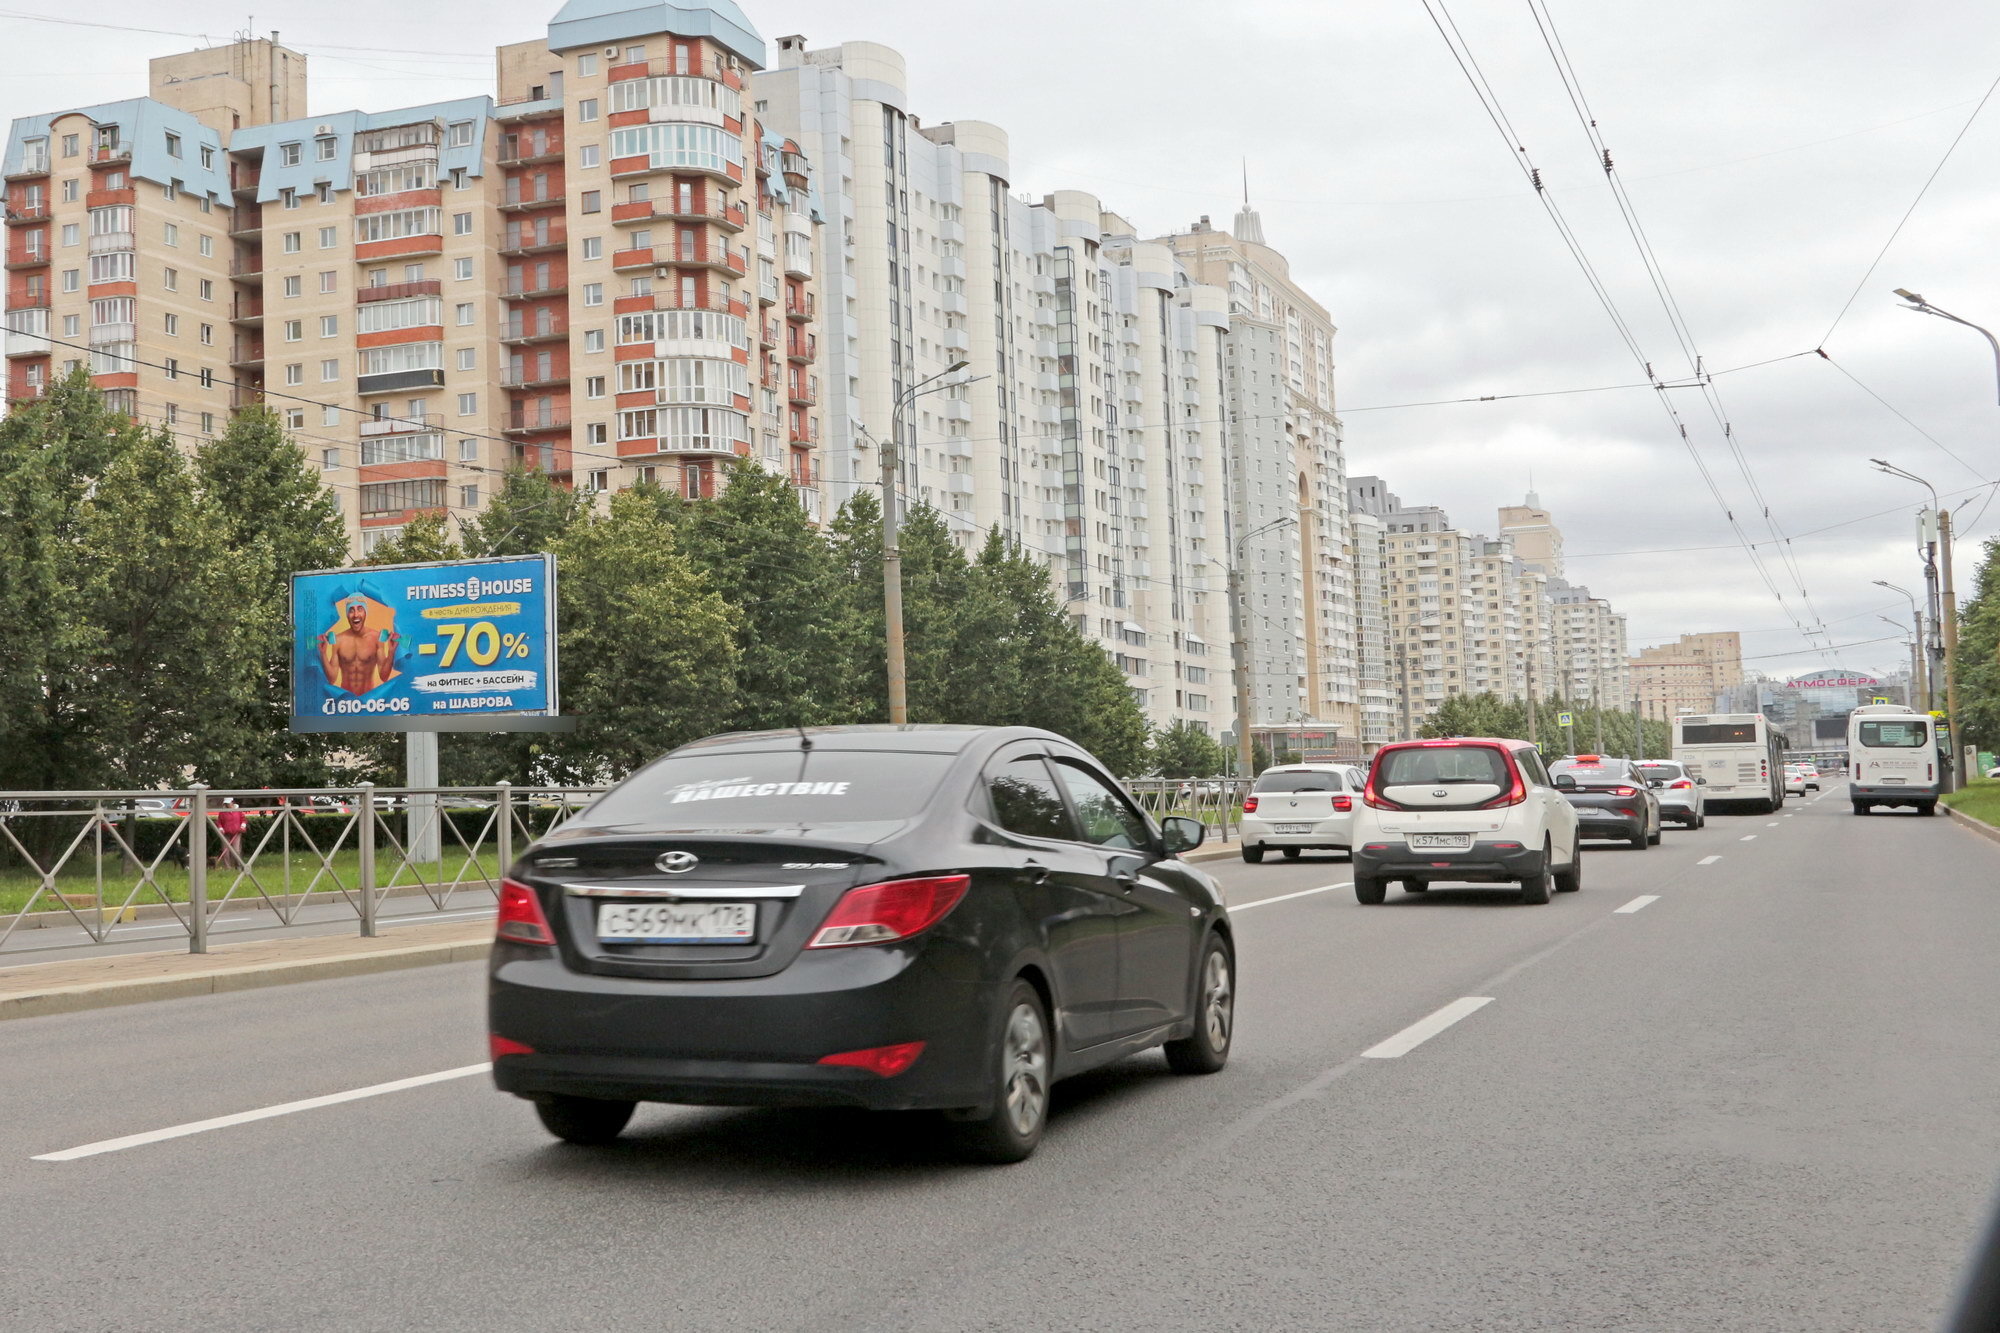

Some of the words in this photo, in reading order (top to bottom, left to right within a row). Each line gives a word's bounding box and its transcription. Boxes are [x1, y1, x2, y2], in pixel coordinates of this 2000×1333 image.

[407, 583, 466, 600] FITNESS
[481, 578, 532, 596] HOUSE
[434, 608, 454, 616] честь
[454, 606, 470, 616] ДНЯ
[471, 604, 512, 614] РОЖДЕНИЯ
[438, 677, 474, 687] ФИТНЕС
[483, 674, 524, 685] БАССЕЙН
[1786, 678, 1878, 688] АТМОСФЕРА
[338, 697, 410, 713] 610-06-06
[433, 700, 446, 710] на
[449, 696, 513, 709] ШАВРОВА
[711, 905, 747, 927] 178
